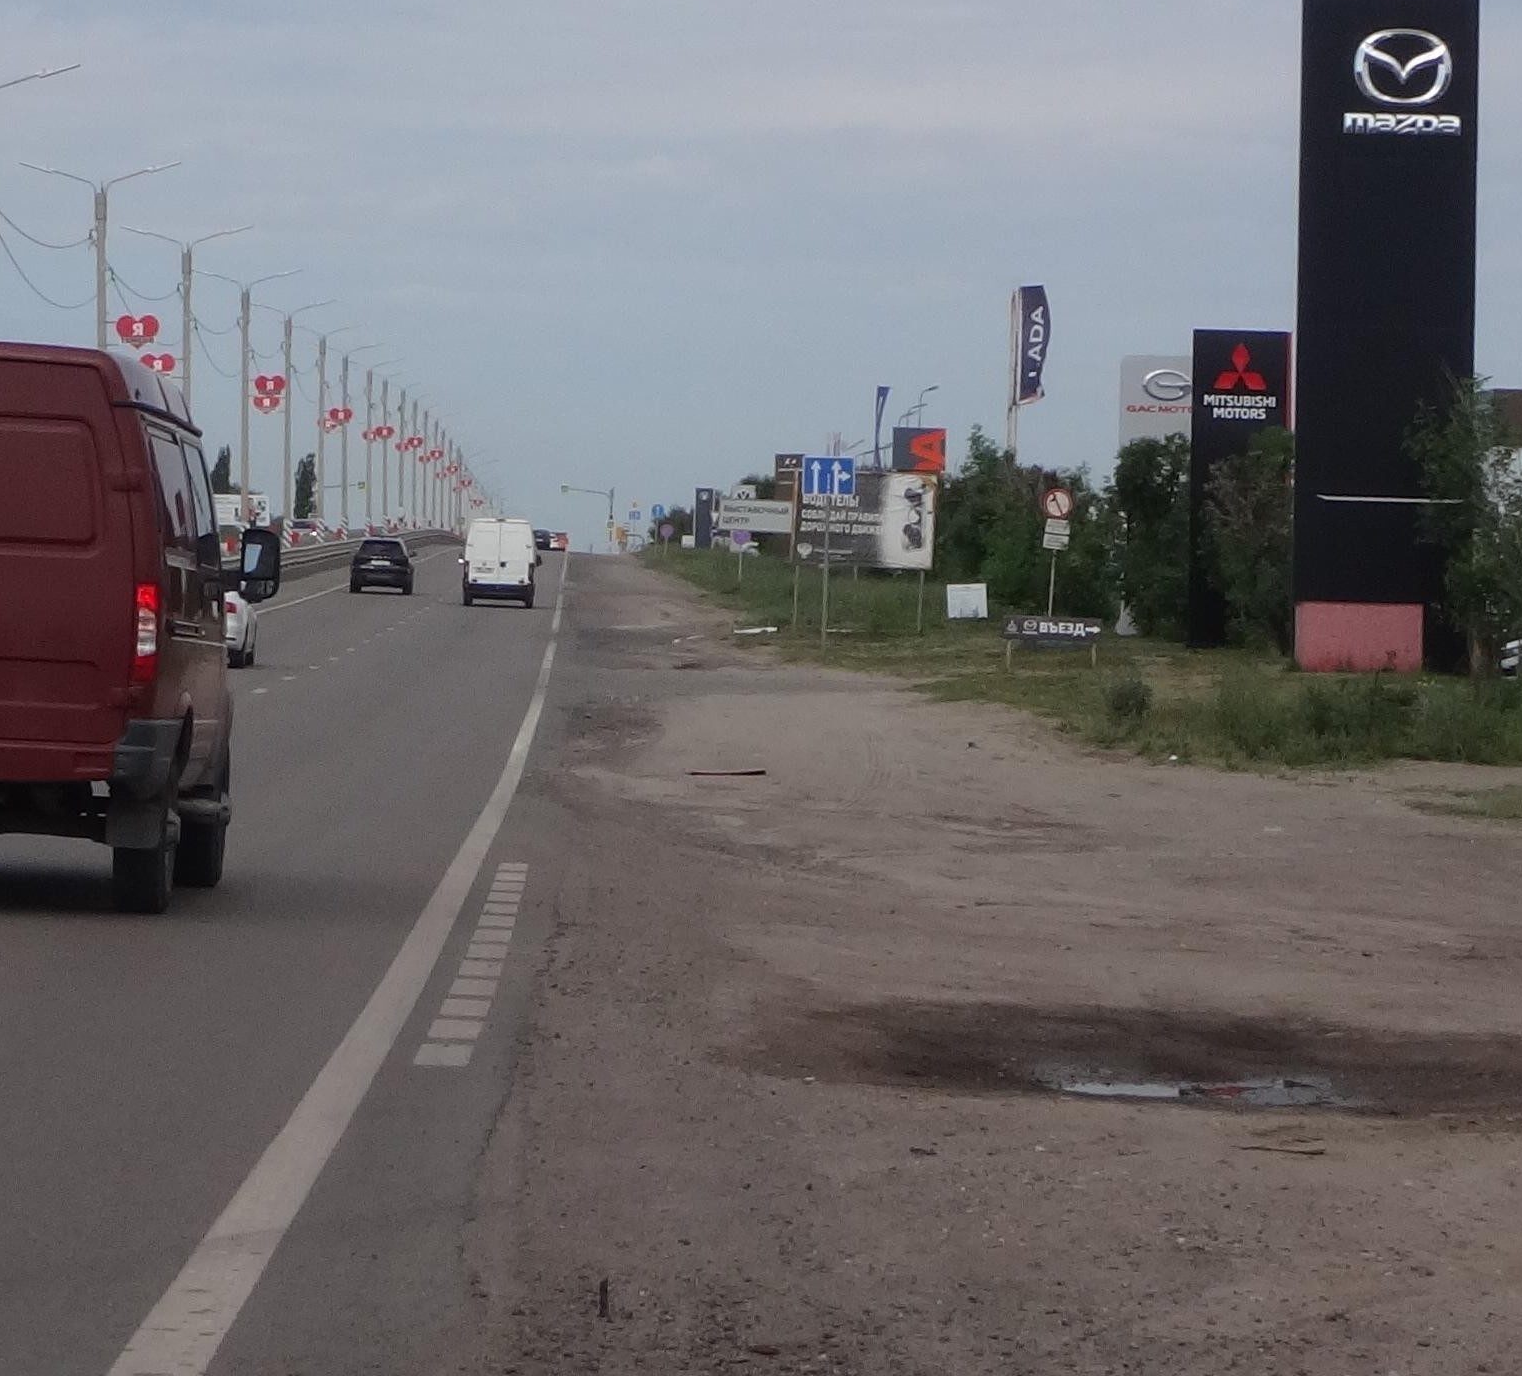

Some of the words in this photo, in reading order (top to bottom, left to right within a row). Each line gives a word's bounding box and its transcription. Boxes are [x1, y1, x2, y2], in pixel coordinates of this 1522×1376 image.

[1203, 394, 1277, 408] MITSUBISHI
[1127, 405, 1157, 413] GAC
[1213, 407, 1267, 420] MOTORS
[1039, 621, 1086, 637] ВЪЕЗД
